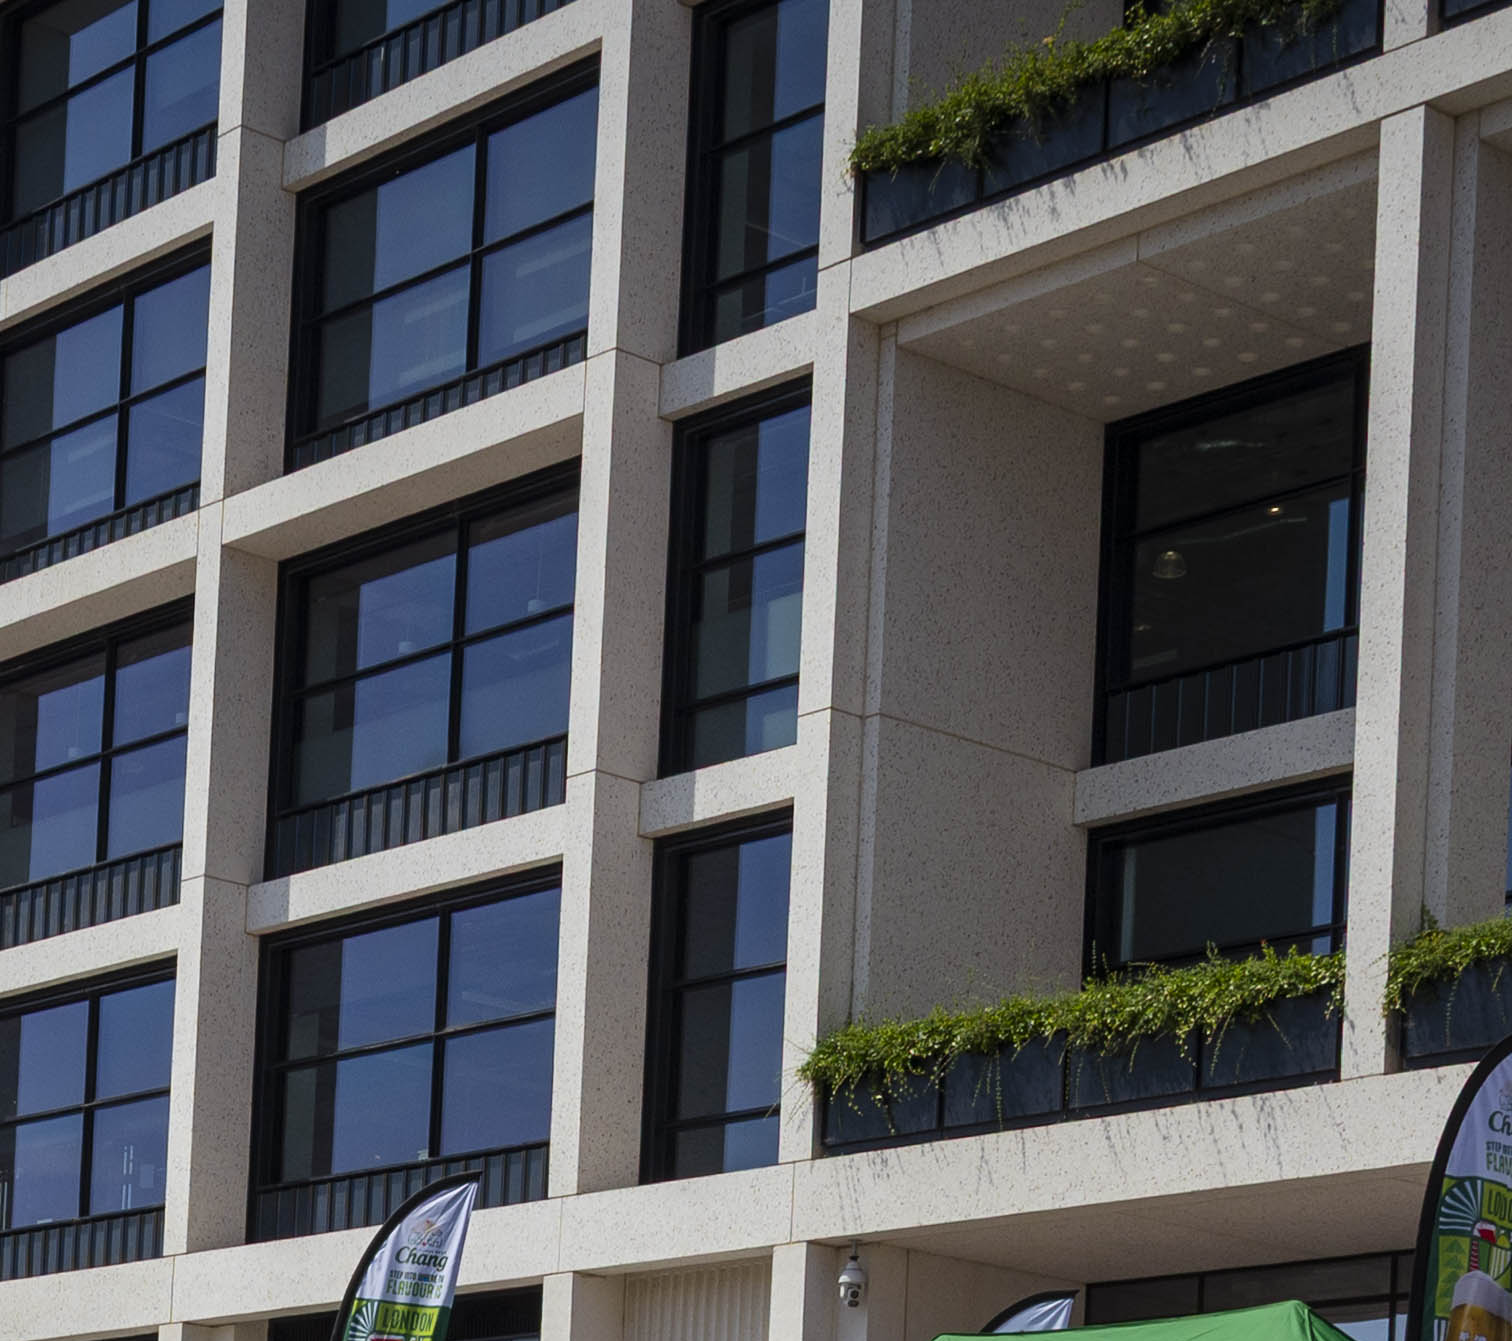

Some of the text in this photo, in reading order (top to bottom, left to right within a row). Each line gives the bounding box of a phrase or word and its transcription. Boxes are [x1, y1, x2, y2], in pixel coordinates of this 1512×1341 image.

[395, 1246, 448, 1272] Chang
[386, 1279, 434, 1298] FLAVOUR
[383, 1308, 433, 1332] LONDON
